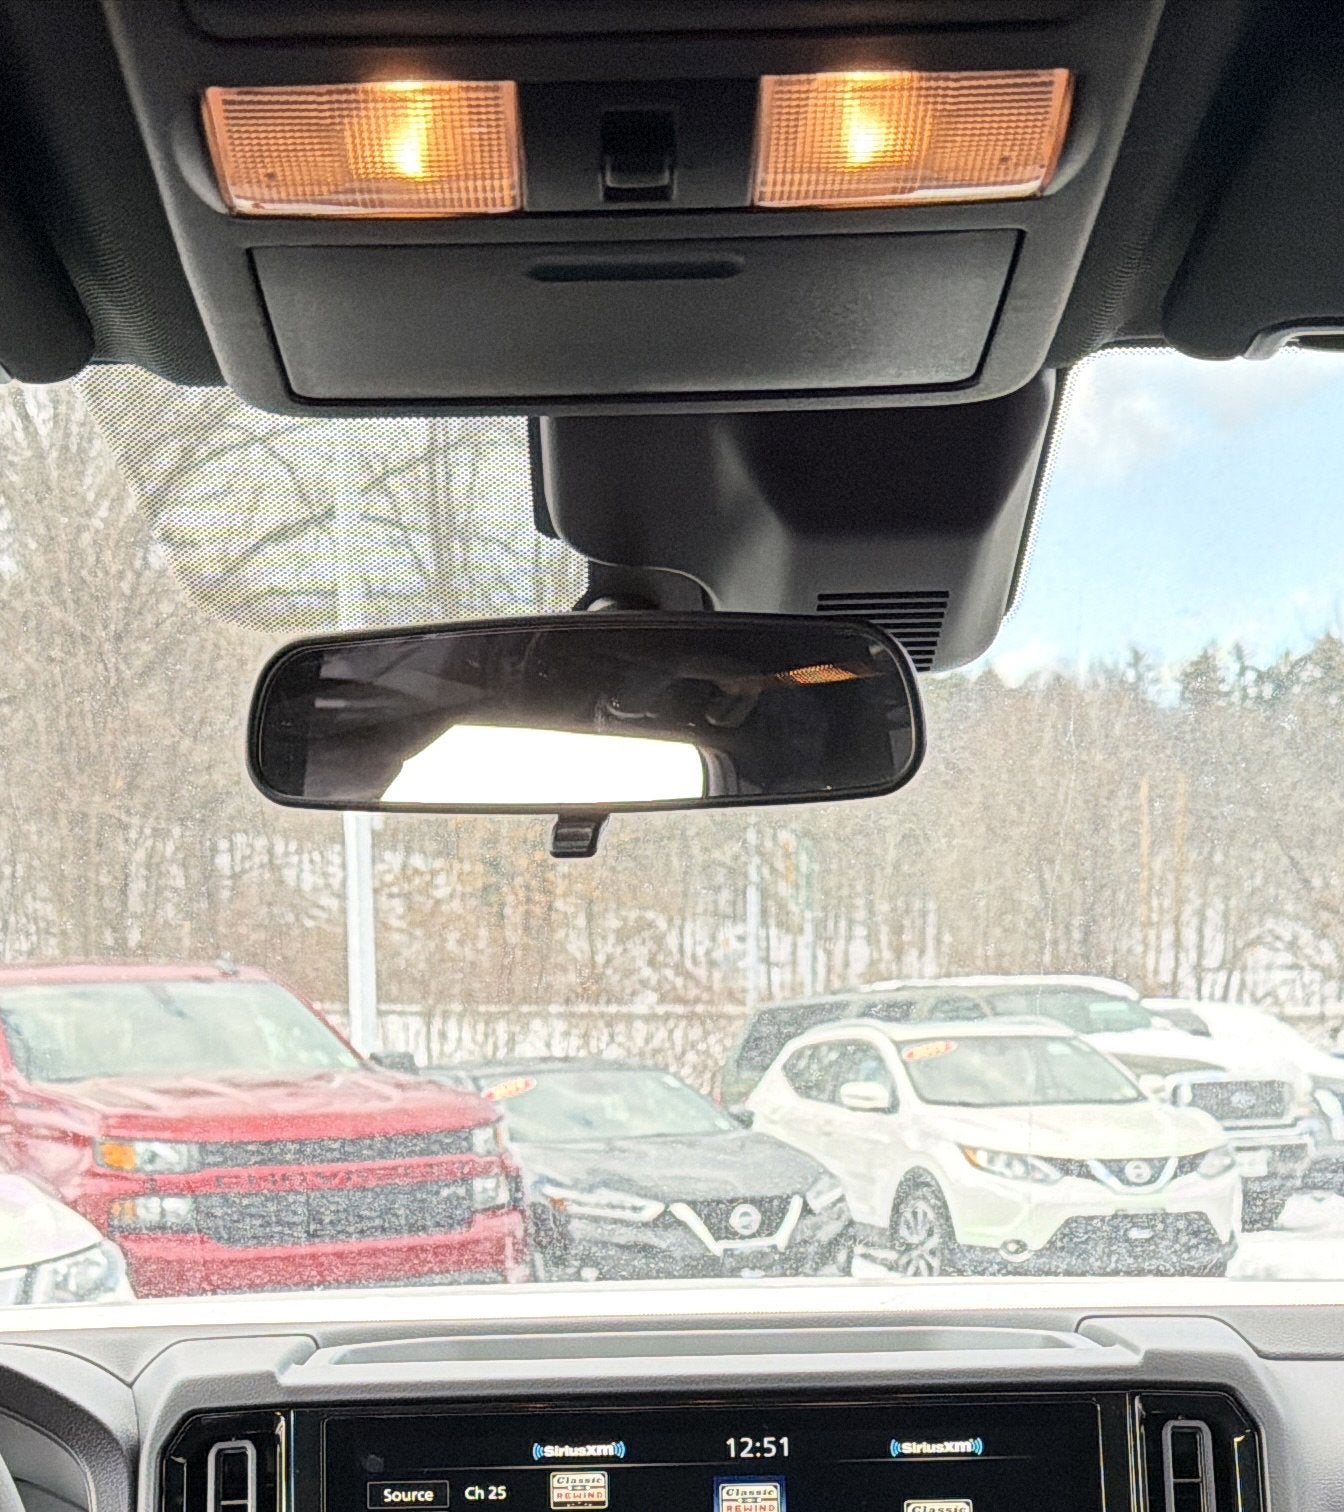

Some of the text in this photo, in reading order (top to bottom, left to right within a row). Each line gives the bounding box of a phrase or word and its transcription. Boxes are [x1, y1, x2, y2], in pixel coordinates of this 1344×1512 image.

[726, 1437, 790, 1458] 12:51
[556, 1476, 603, 1485] Classic
[383, 1489, 435, 1502] Source
[464, 1485, 507, 1500] Ch 25
[556, 1491, 603, 1500] REWIND
[725, 1488, 775, 1497] Classic
[726, 1504, 776, 1512] REWIND
